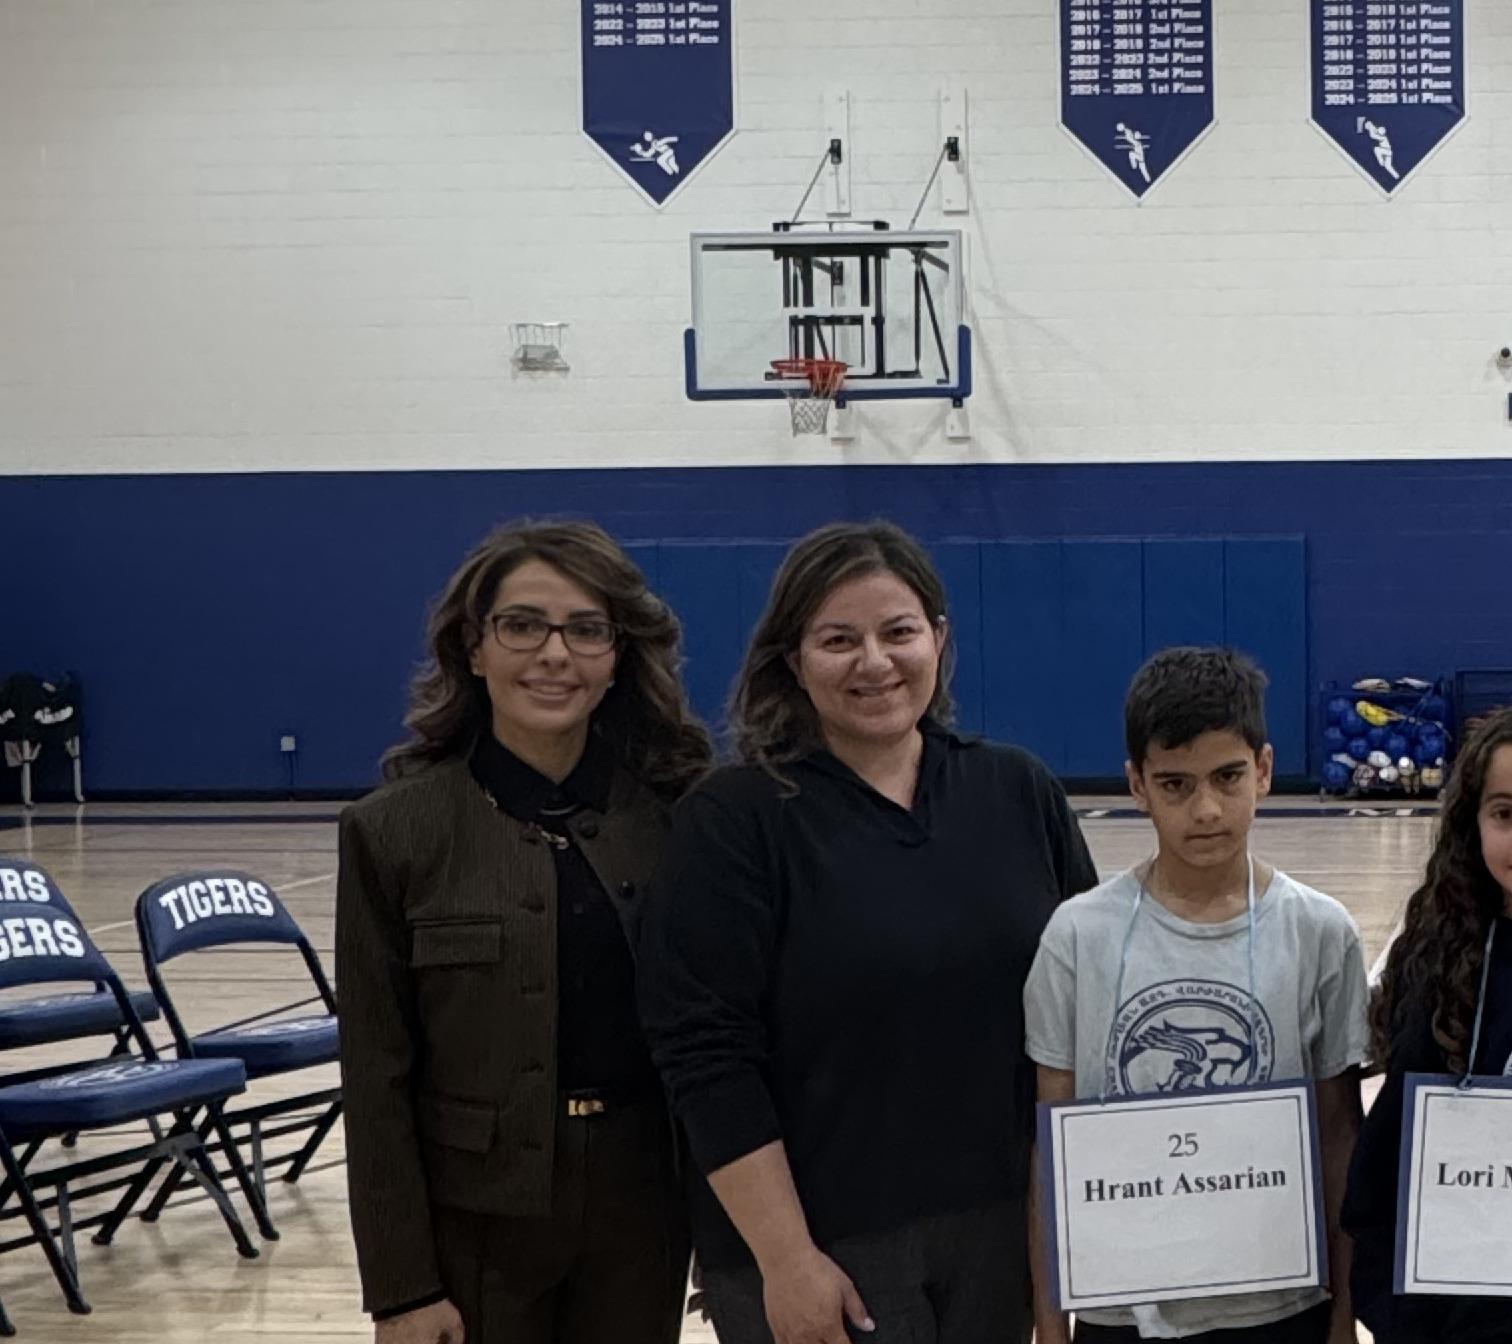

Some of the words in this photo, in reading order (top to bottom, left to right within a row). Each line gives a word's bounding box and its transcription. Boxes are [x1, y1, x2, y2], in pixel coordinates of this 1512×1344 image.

[0, 868, 51, 902] RS
[159, 878, 274, 930] TIGERS
[1168, 1134, 1199, 1157] 25
[1083, 1174, 1164, 1201] Hrant
[1172, 1166, 1287, 1197] Assarian
[1436, 1162, 1494, 1189] Lori
